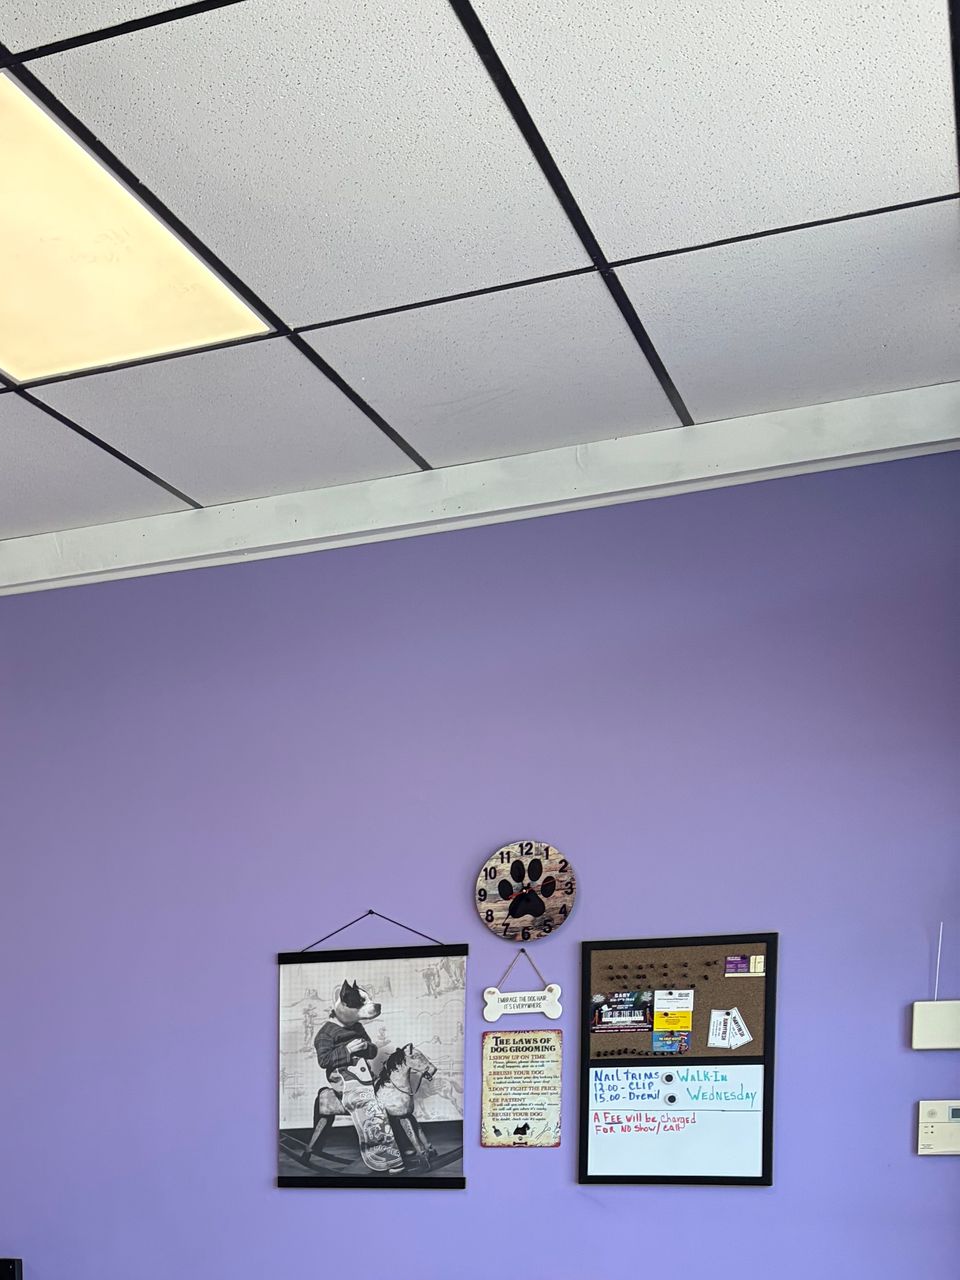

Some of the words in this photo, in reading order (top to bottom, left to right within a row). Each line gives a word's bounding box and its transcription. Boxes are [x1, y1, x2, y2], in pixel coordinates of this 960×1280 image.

[519, 842, 533, 856] 12
[544, 846, 550, 859] 1
[499, 851, 511, 863] 11
[559, 859, 568, 873] 2
[483, 866, 497, 880] 10
[564, 881, 574, 895] 3
[478, 888, 487, 902] 9
[485, 909, 494, 922] 8
[560, 904, 567, 917] 4
[502, 922, 510, 936] 7
[543, 920, 552, 933] 5
[522, 927, 530, 940] 6
[492, 1036, 511, 1046] THE
[510, 1045, 556, 1053] GROOMING
[628, 1081, 654, 1090] CLIP
[594, 1093, 620, 1104] 15.00
[594, 1112, 600, 1123] A
[604, 1112, 623, 1124] FEE
[645, 1113, 657, 1122] be
